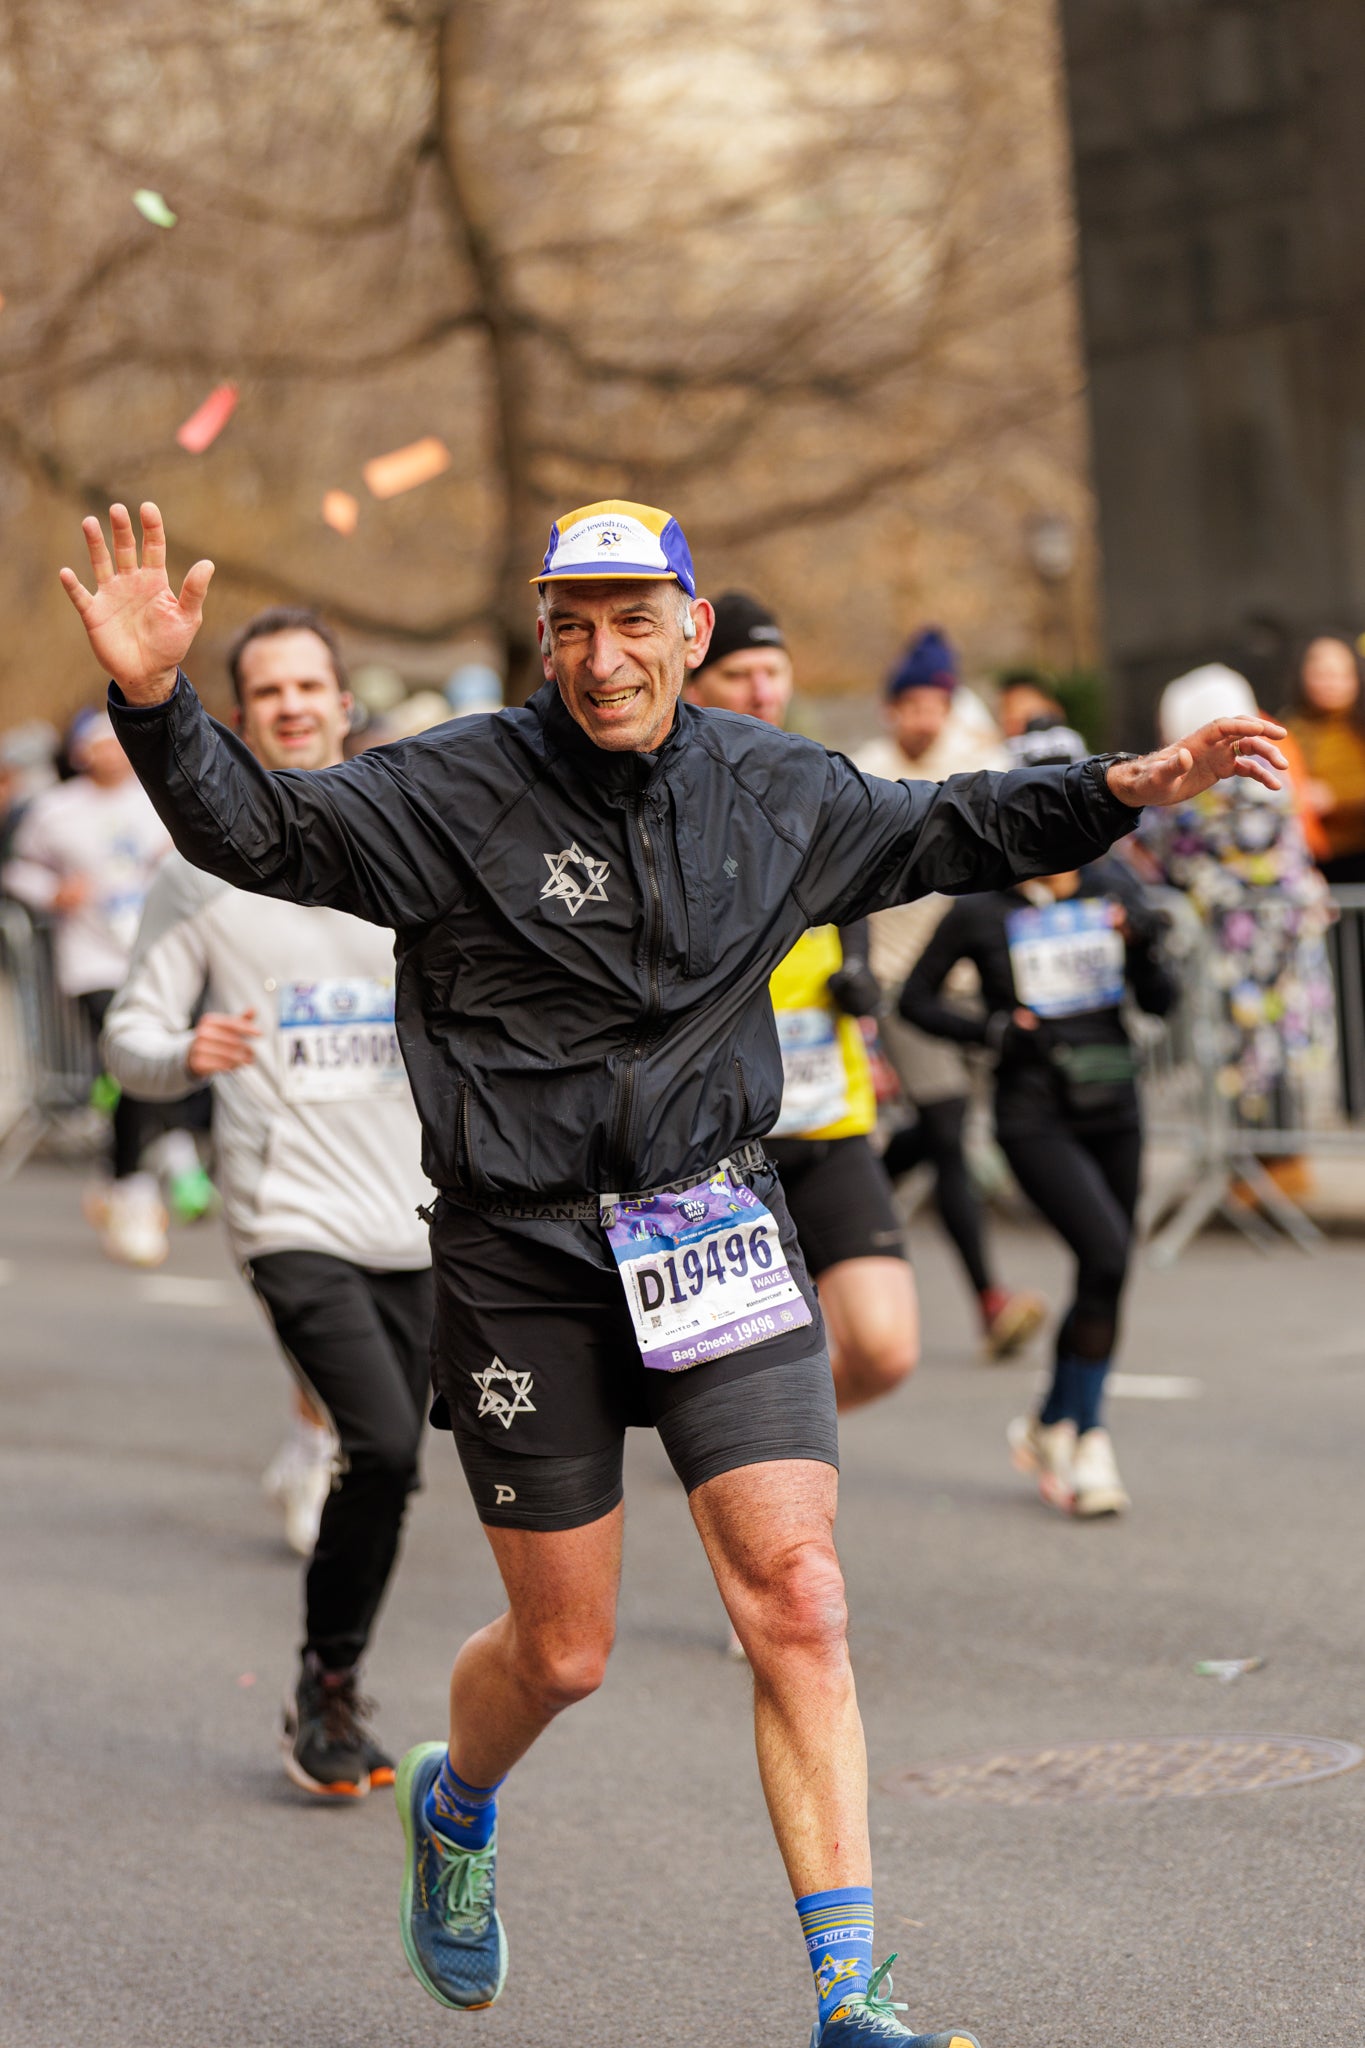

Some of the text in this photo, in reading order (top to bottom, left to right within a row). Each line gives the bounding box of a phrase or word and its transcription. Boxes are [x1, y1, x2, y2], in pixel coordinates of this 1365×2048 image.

[587, 520, 615, 532] Jewish
[683, 1200, 705, 1213] NYC
[688, 1208, 706, 1219] HALF
[636, 1225, 773, 1313] D19496
[753, 1269, 790, 1289] WAVE 3
[665, 1324, 692, 1336] UNITED
[671, 1346, 697, 1363] Bag
[696, 1331, 735, 1353] Check
[734, 1314, 776, 1341] 19496
[823, 1930, 860, 1943] NICE
